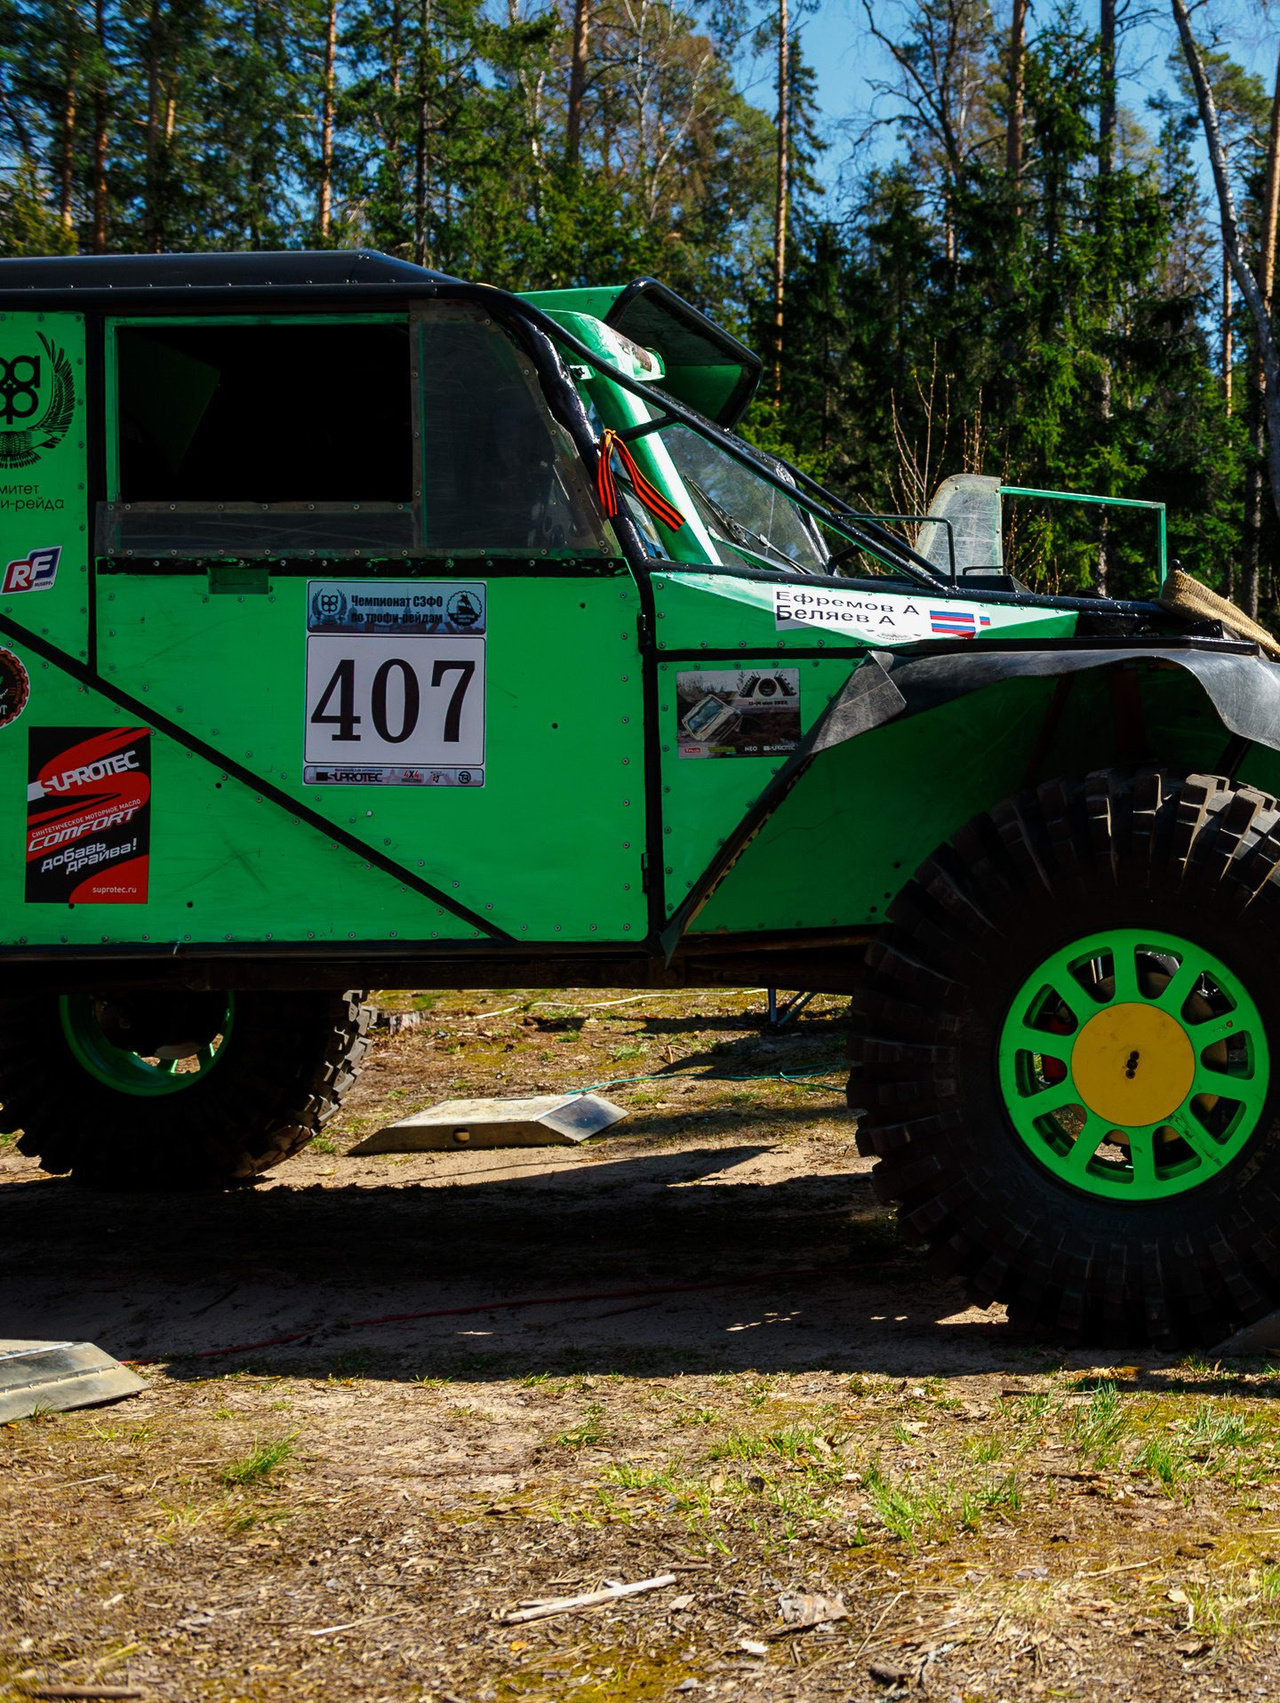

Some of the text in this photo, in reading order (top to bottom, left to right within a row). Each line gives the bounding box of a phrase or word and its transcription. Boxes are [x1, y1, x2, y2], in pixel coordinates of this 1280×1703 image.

[351, 595, 443, 607] Чемпионат СЗФО
[776, 591, 894, 612] Ефремов
[776, 605, 870, 622] Беляев
[351, 612, 364, 623] по
[366, 611, 443, 624] трофи-рейдам
[311, 658, 475, 744] 407
[41, 750, 139, 796] SUPROTEC
[318, 771, 383, 782] SUPROTEC
[28, 806, 139, 852] COMFORT
[31, 799, 141, 838] СИНТЕТИЧЕСКОЕ МОТОРНОЕ МАСЛО
[41, 842, 107, 873] добавь
[65, 837, 137, 875] драйва!
[92, 886, 137, 895] suprotec.ru
